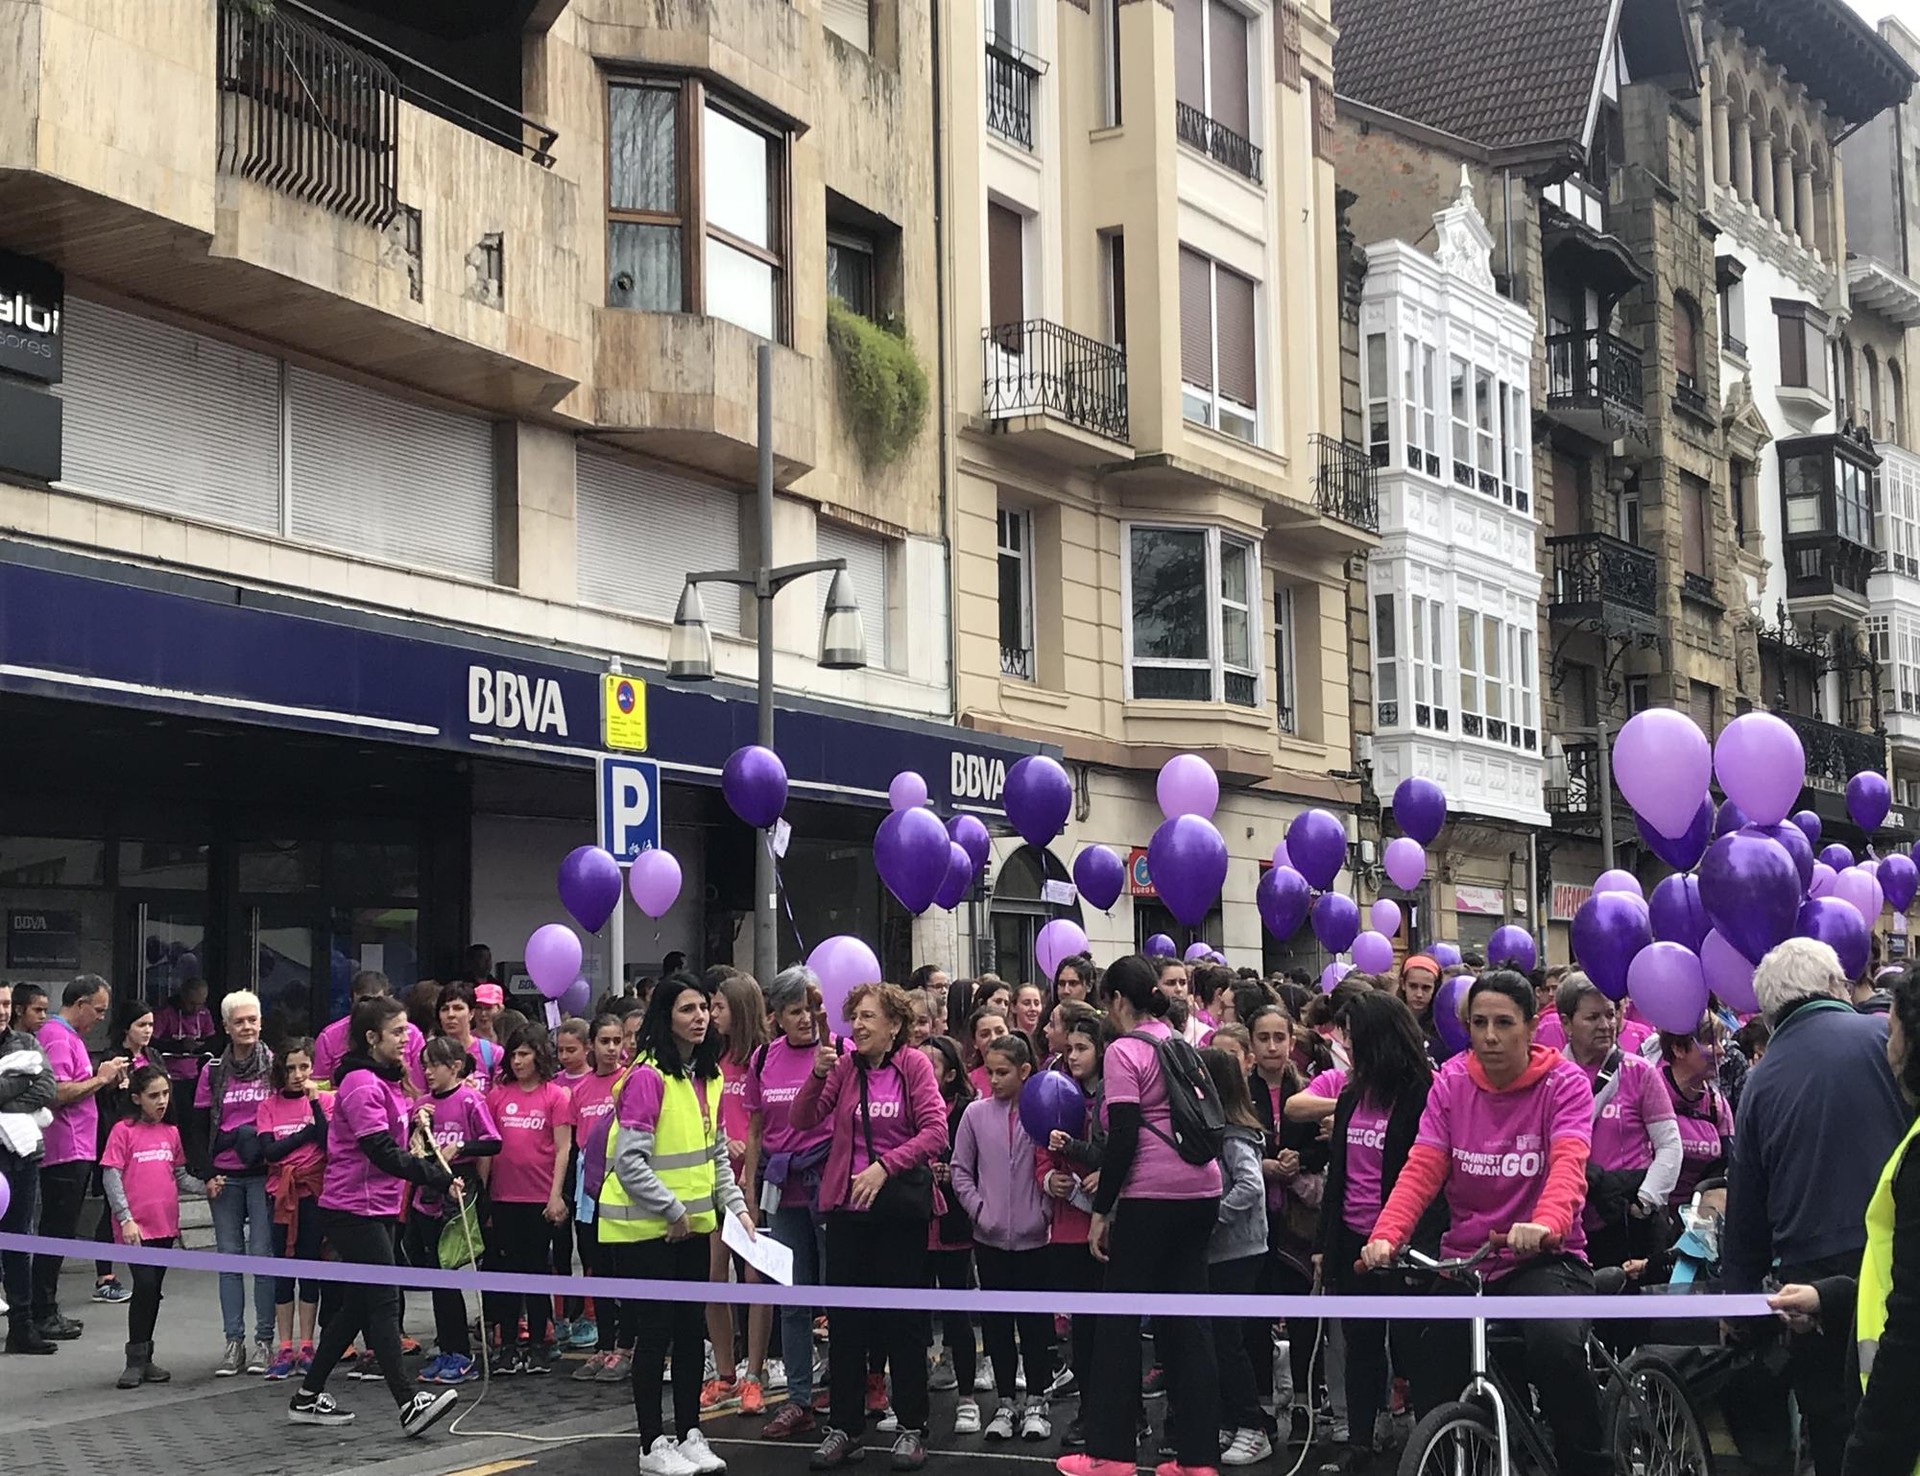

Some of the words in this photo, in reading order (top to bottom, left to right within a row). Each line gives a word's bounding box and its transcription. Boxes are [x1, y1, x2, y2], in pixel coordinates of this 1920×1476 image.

[469, 665, 568, 736] BBVA
[611, 766, 649, 855] P
[869, 1101, 899, 1118] GO!
[1602, 1104, 1622, 1119] O!
[522, 1117, 546, 1130] GO!
[1363, 1130, 1386, 1150] GO
[1452, 1147, 1502, 1165] FEMINIST
[1501, 1151, 1544, 1177] GO!
[1461, 1162, 1500, 1176] DURAN
